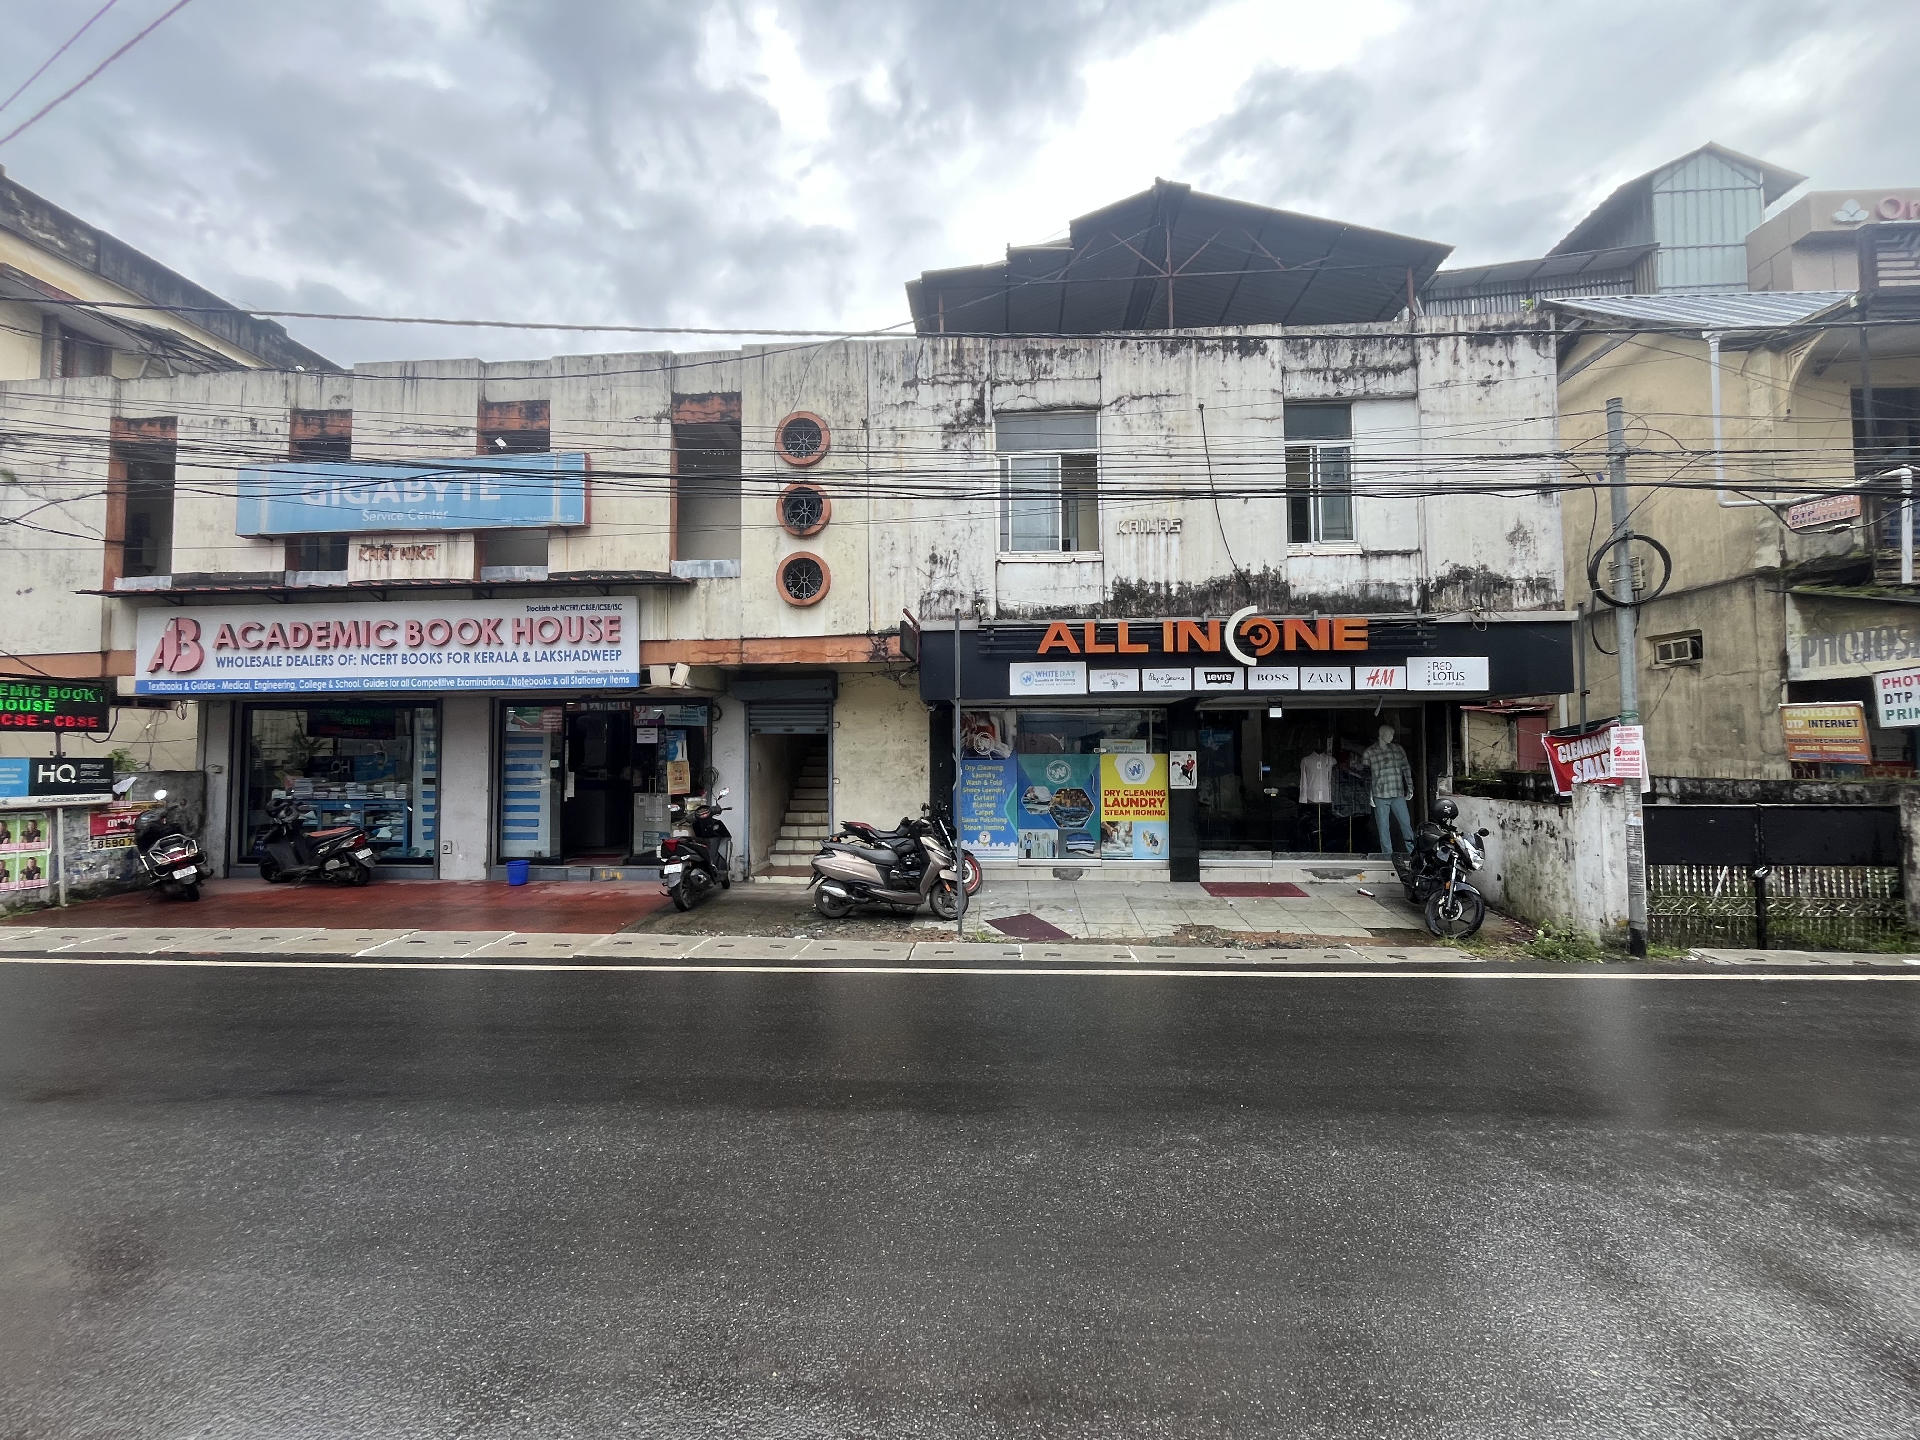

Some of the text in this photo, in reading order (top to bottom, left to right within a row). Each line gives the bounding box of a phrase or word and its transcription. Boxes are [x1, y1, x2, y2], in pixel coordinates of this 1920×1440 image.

[301, 473, 501, 505] GIGABYTE
[362, 508, 449, 522] Service Center
[1792, 510, 1815, 520] DTP
[1116, 518, 1182, 534] KAILAS
[526, 604, 551, 612] Stockists
[212, 615, 622, 650] ACADEMIC BOOK HOUSE
[1036, 621, 1149, 654] ALL
[1162, 620, 1221, 653] IN
[215, 649, 622, 668] WHOLESALE DEALERS OF: NCERT BOOKS FOR KERALA & LAKSHADWEEP
[1432, 661, 1453, 670] RED
[1256, 674, 1289, 682] BOSS
[1307, 672, 1344, 684] ZARA
[1366, 668, 1395, 687] H&M
[1432, 671, 1465, 681] LOTUS
[148, 681, 182, 691] Textbooks
[183, 681, 190, 690] &
[191, 681, 216, 690] Guides
[299, 680, 327, 690] College
[328, 680, 334, 688] &
[363, 679, 388, 688] Guides
[389, 678, 399, 688] for
[400, 678, 410, 688] all
[411, 678, 455, 689] Competitive
[456, 677, 504, 687] Examinations
[511, 676, 552, 686] Notebooks
[553, 676, 559, 685] &
[560, 676, 570, 685] all
[570, 675, 607, 686] Stationery
[609, 675, 630, 684] Items
[1884, 691, 1913, 705] DTP
[0, 699, 56, 712] OUSE
[54, 715, 98, 727] CBSE
[1807, 719, 1859, 728] INTERNET
[1557, 729, 1611, 764] CLEARANC
[1571, 753, 1611, 784] SALE
[1104, 789, 1166, 797] DRY CLEANING
[1104, 797, 1166, 808] LAUNDRY
